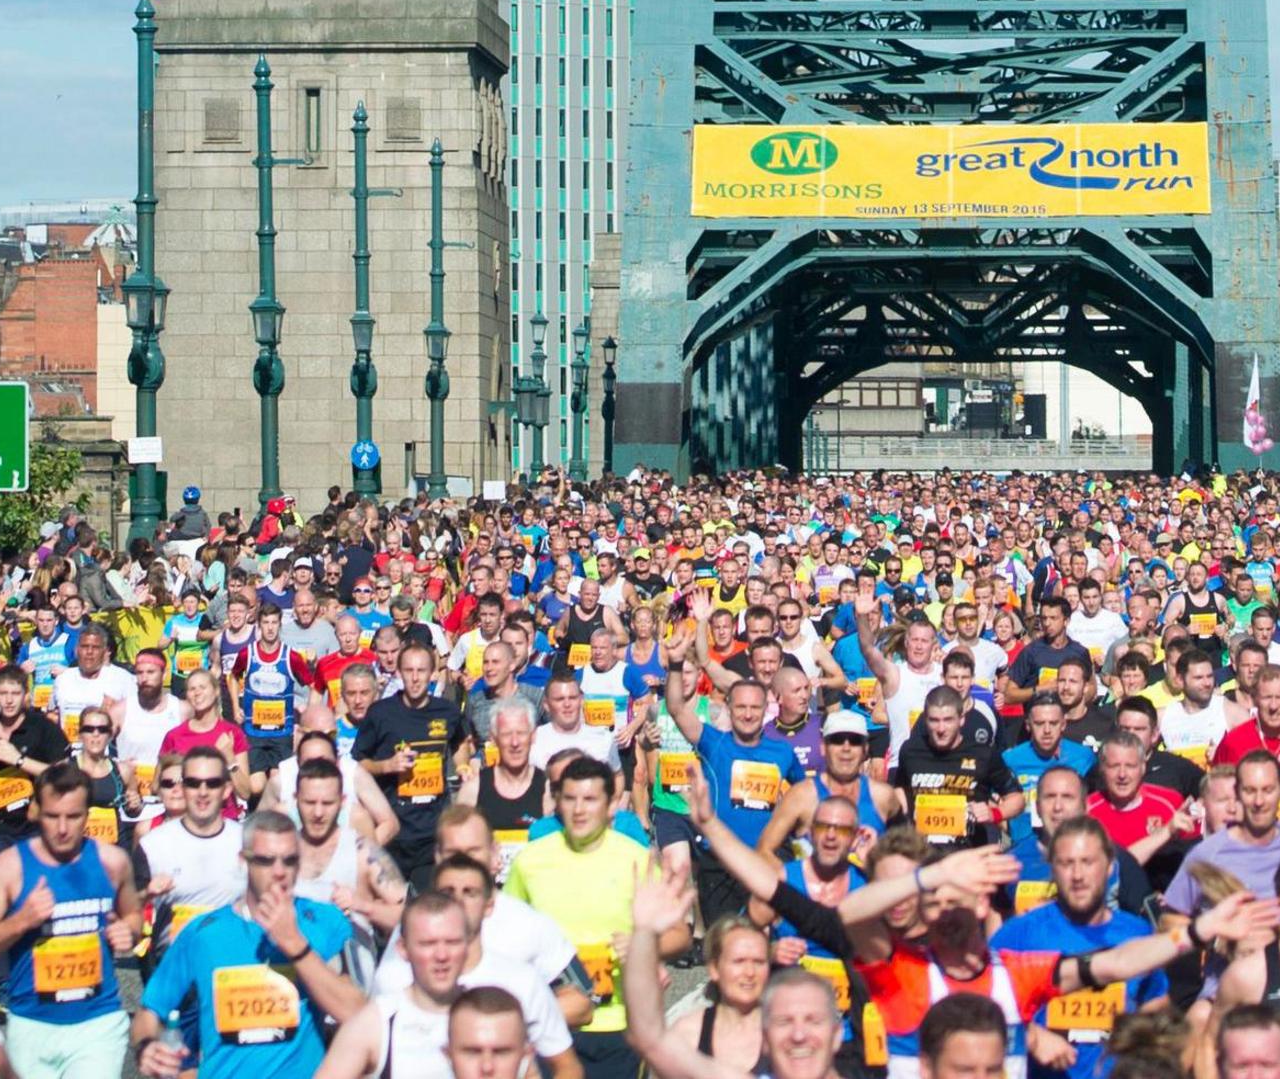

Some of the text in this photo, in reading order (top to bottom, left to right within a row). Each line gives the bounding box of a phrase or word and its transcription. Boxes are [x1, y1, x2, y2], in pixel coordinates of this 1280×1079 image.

[766, 139, 820, 169] M
[915, 143, 1178, 177] great north
[703, 182, 884, 199] MORRISONS
[1123, 175, 1193, 191] run
[855, 203, 1046, 215] SUNDAY 13 SEPTEMBER 2015
[924, 816, 955, 827] 4991
[45, 960, 96, 979] 12752
[227, 997, 289, 1016] 12023
[1061, 1000, 1116, 1016] 12124
